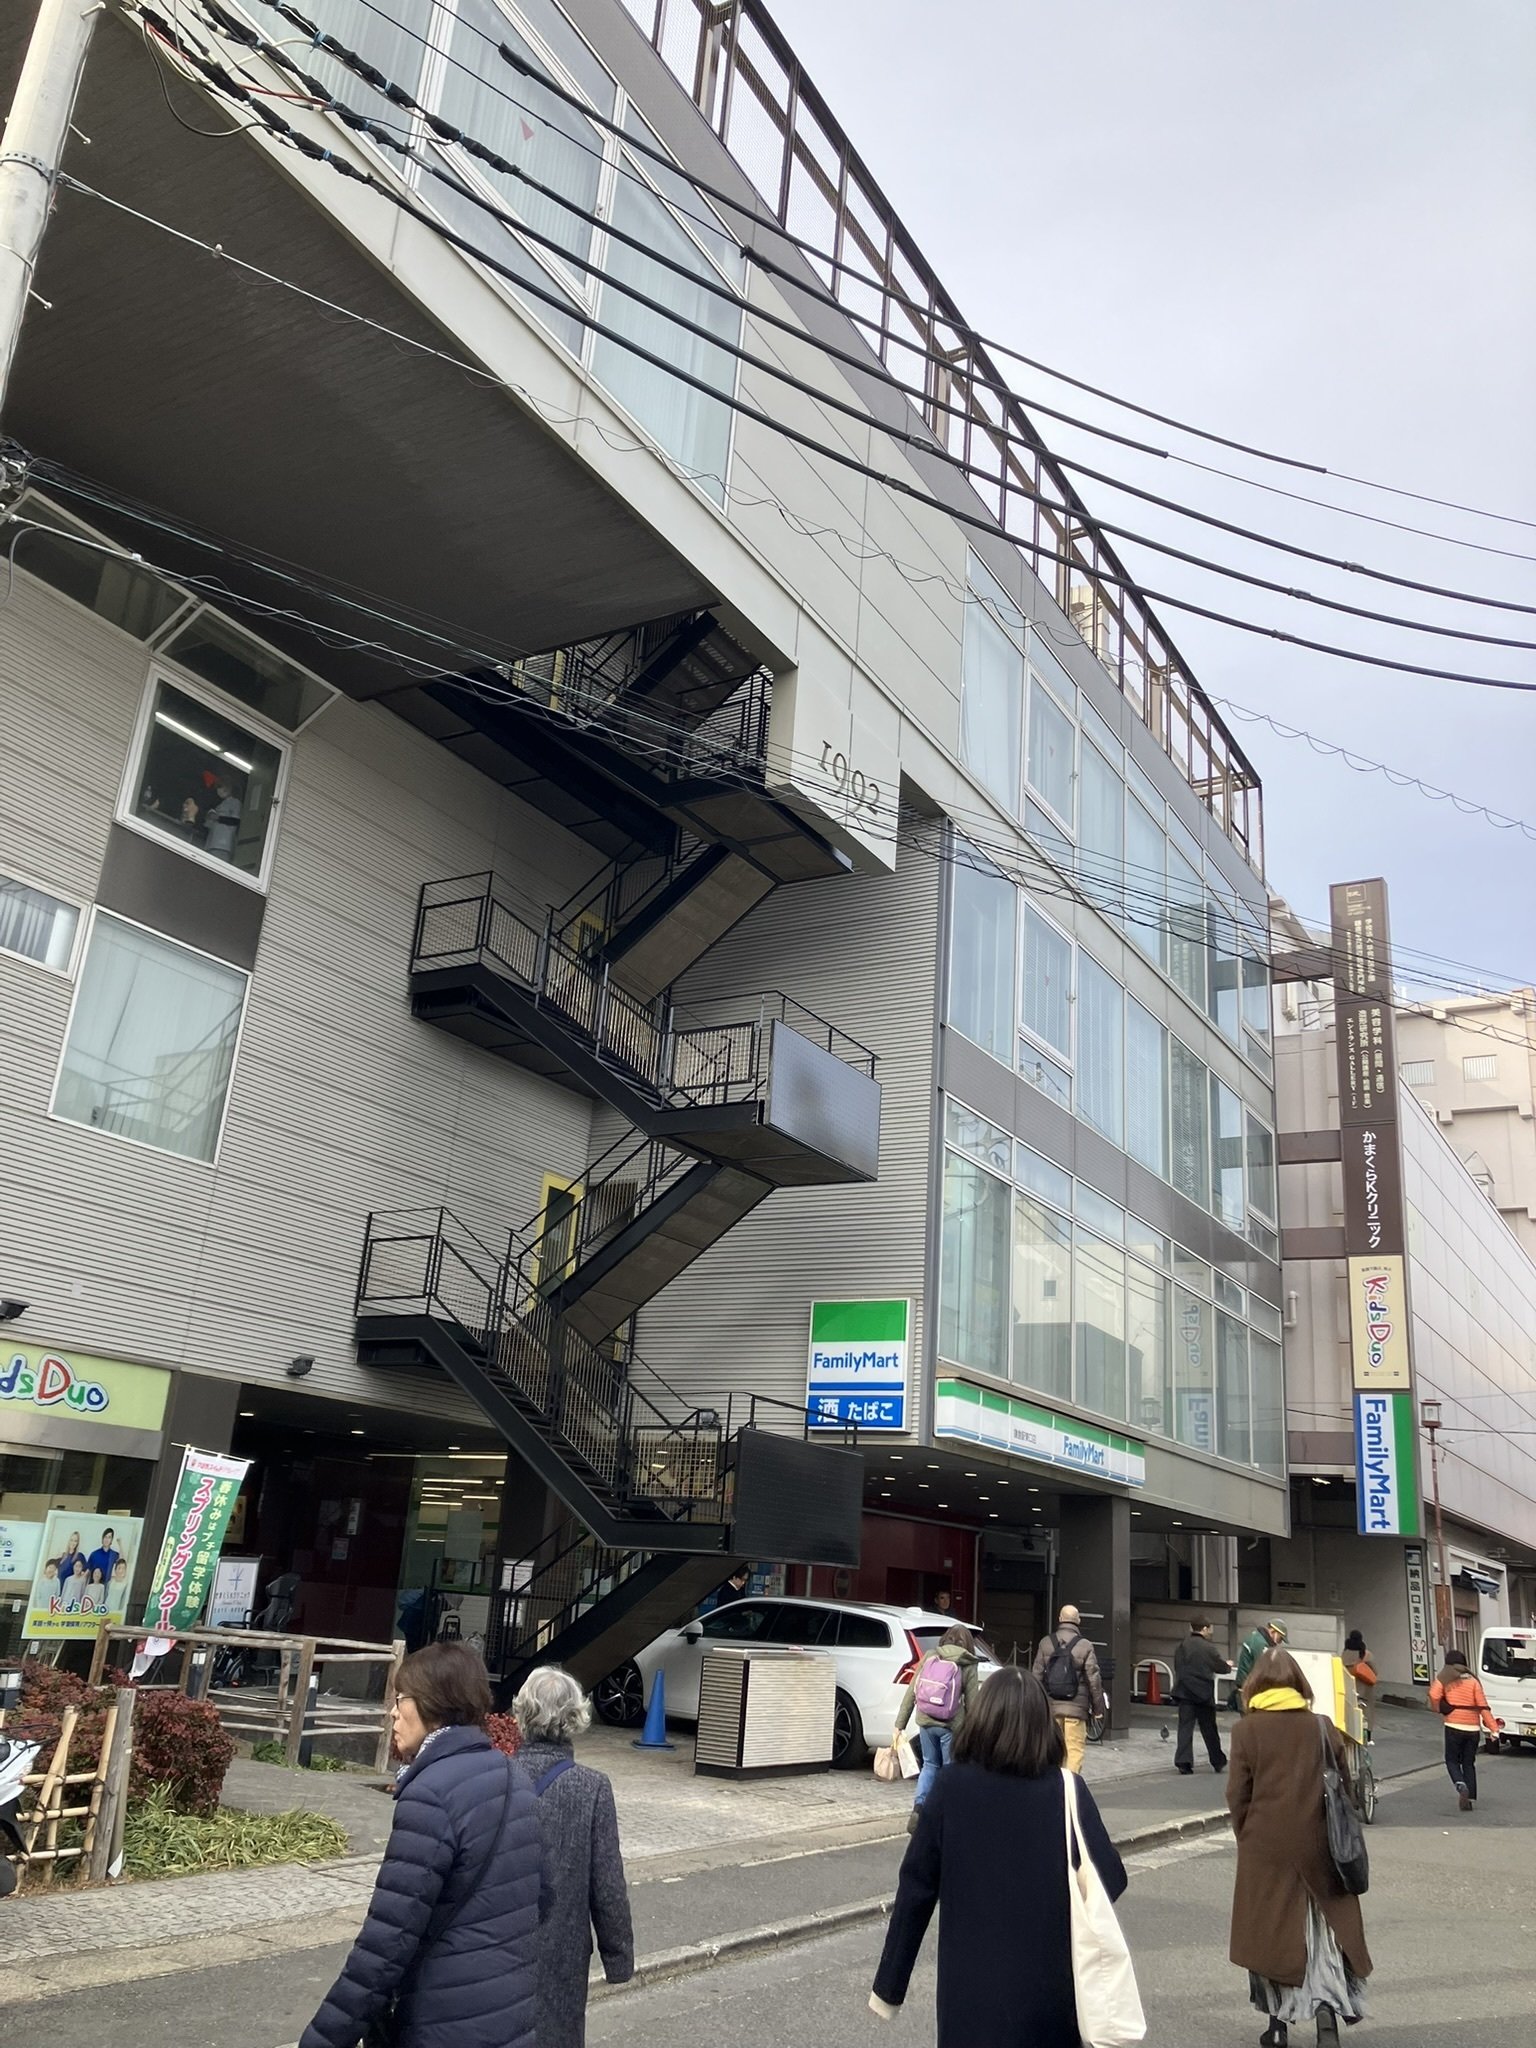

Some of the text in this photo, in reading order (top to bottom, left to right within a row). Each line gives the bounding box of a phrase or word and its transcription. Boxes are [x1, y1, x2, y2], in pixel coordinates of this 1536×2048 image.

[1362, 1130, 1381, 1248] かまくらKクリニック
[1365, 1276, 1392, 1365] KidsDuo
[813, 1351, 899, 1373] FamilyMart
[817, 1398, 894, 1424] 酒 たばこ
[1063, 1435, 1104, 1465] FamilyMart
[1365, 1399, 1391, 1529] FamilyMart
[1411, 1640, 1426, 1652] 3.2
